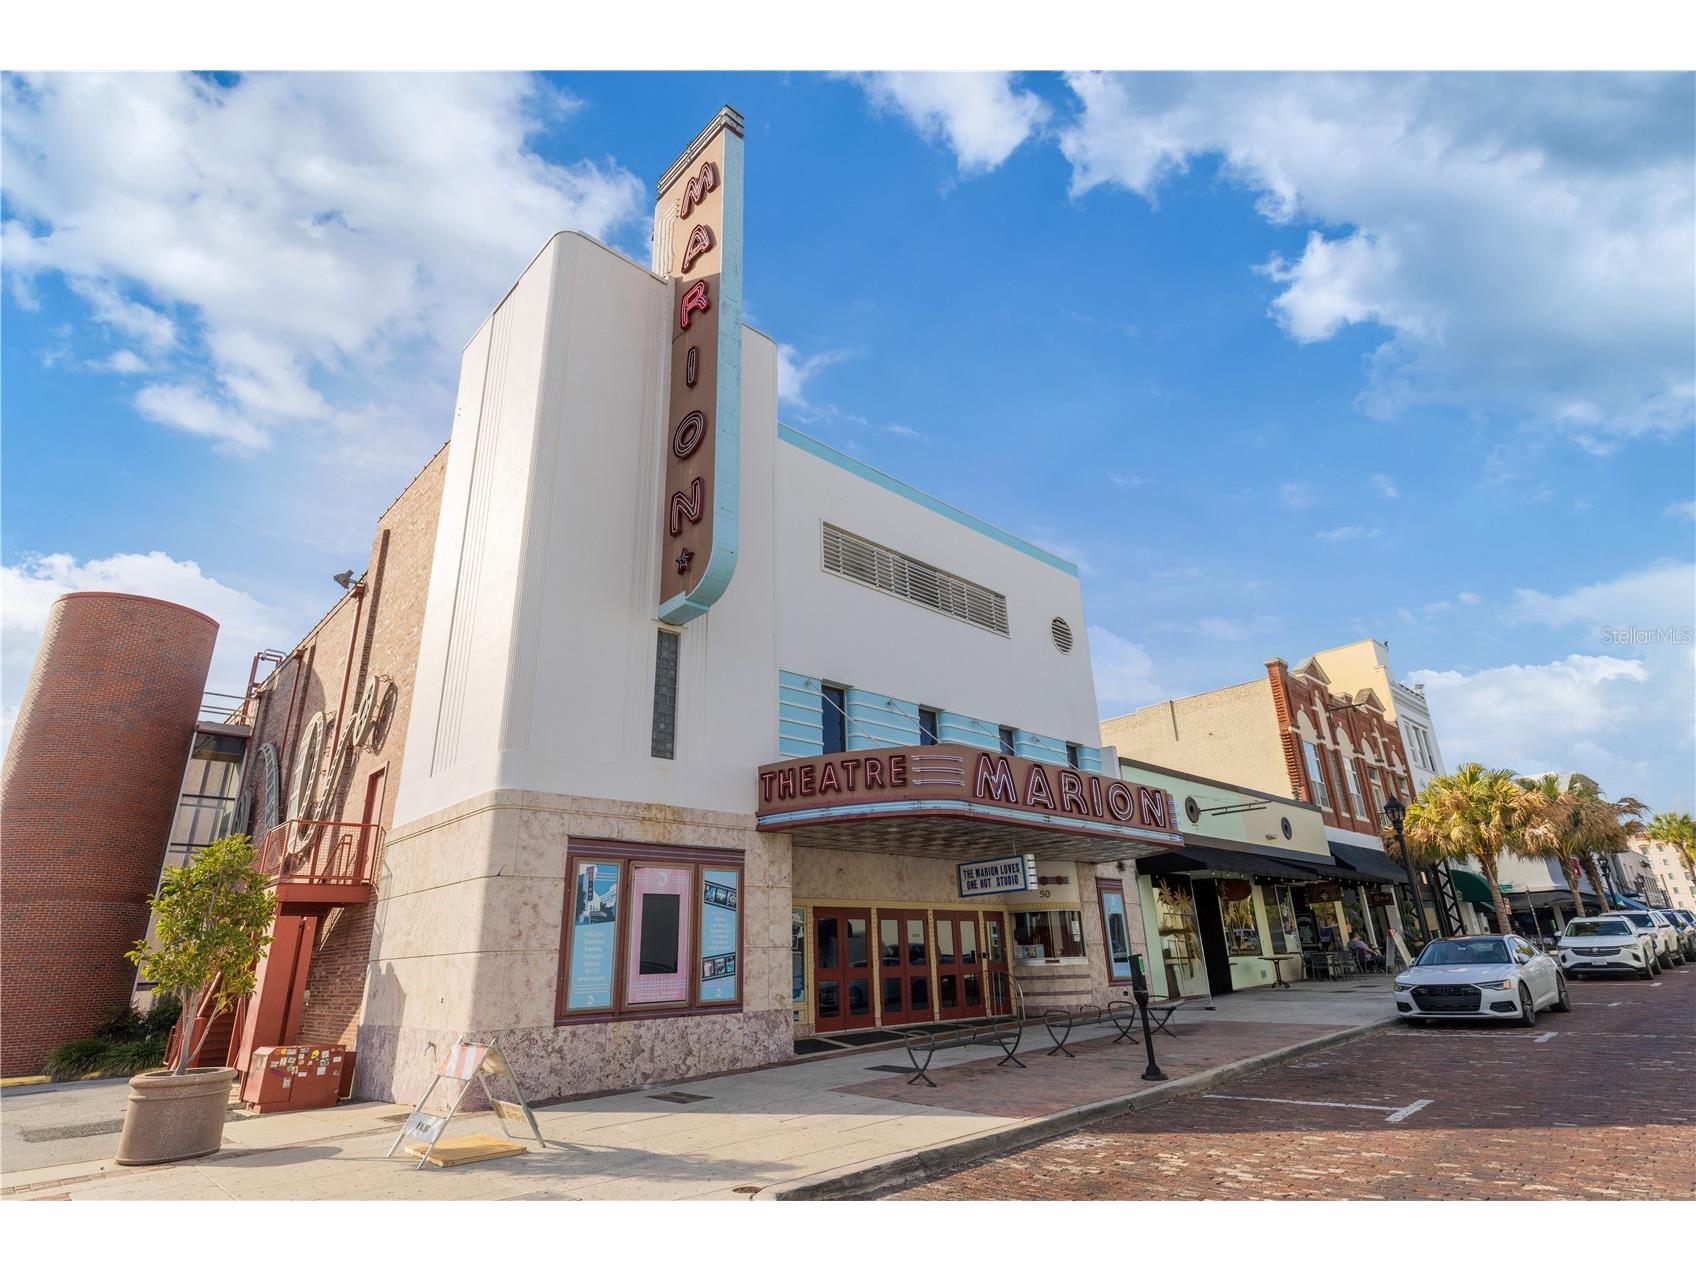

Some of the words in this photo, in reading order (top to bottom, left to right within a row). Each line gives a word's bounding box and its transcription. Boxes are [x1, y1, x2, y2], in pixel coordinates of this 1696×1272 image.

[669, 160, 716, 537] MARION
[760, 753, 908, 803] THEATRE
[974, 752, 1167, 828] MARION
[963, 869, 974, 879] THE
[975, 866, 999, 877] MARION
[1000, 863, 1020, 875] LOVES
[966, 879, 978, 890] ONE
[980, 878, 991, 889] HOT
[996, 874, 1019, 887] STUDIO
[1039, 889, 1051, 899] 50
